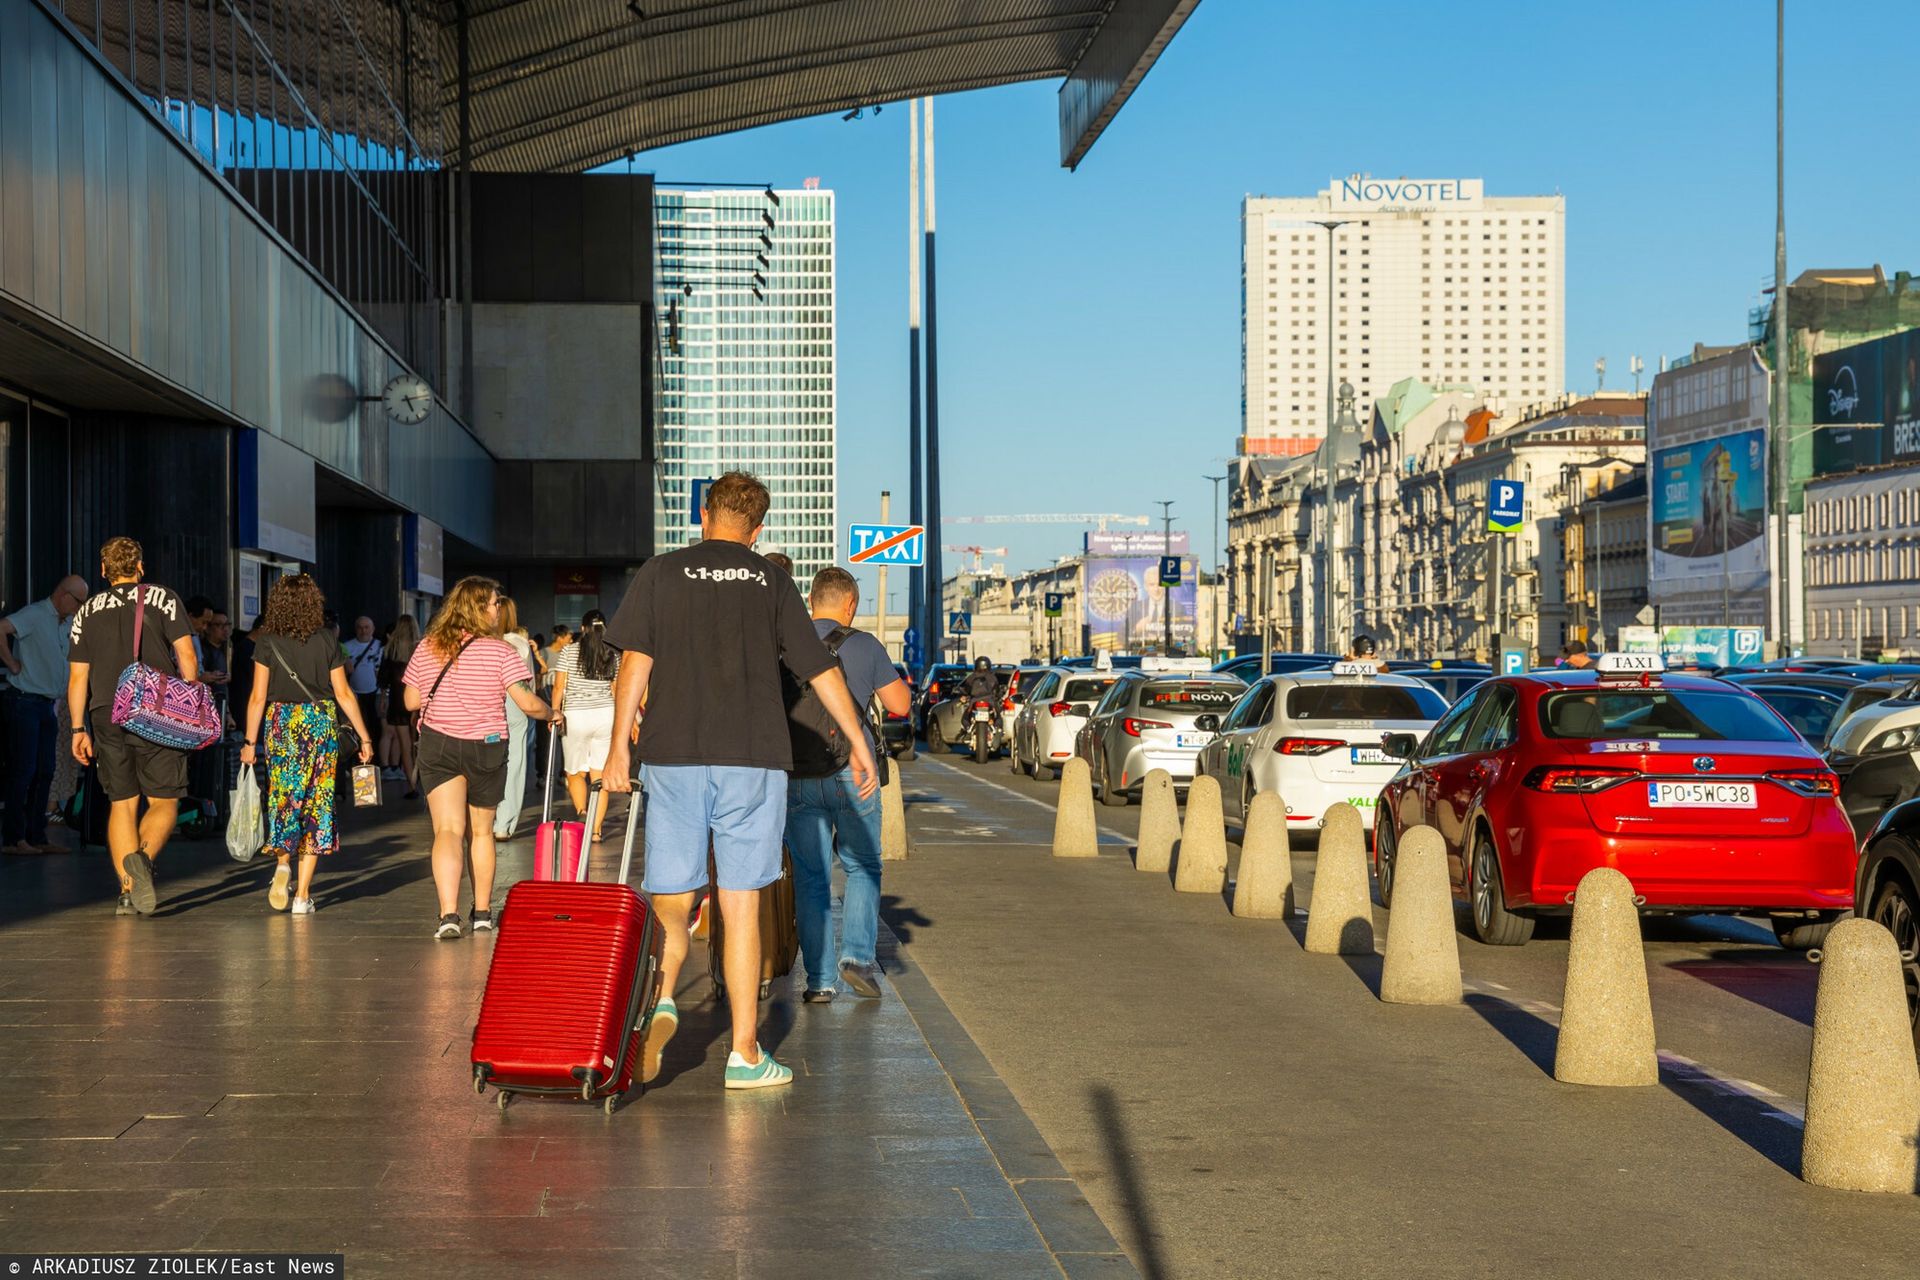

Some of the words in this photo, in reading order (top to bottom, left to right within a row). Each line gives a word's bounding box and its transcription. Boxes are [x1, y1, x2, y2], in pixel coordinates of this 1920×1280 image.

[1342, 180, 1472, 202] NOVOTEL
[1500, 486, 1514, 508] P
[854, 529, 919, 560] TAXI
[1167, 560, 1176, 573] P
[1050, 595, 1058, 608] P
[1341, 665, 1372, 673] TAXI
[1507, 655, 1522, 673] P
[1613, 657, 1652, 668] TAXI
[1661, 784, 1685, 802] PO
[1694, 784, 1750, 803] 5WC38
